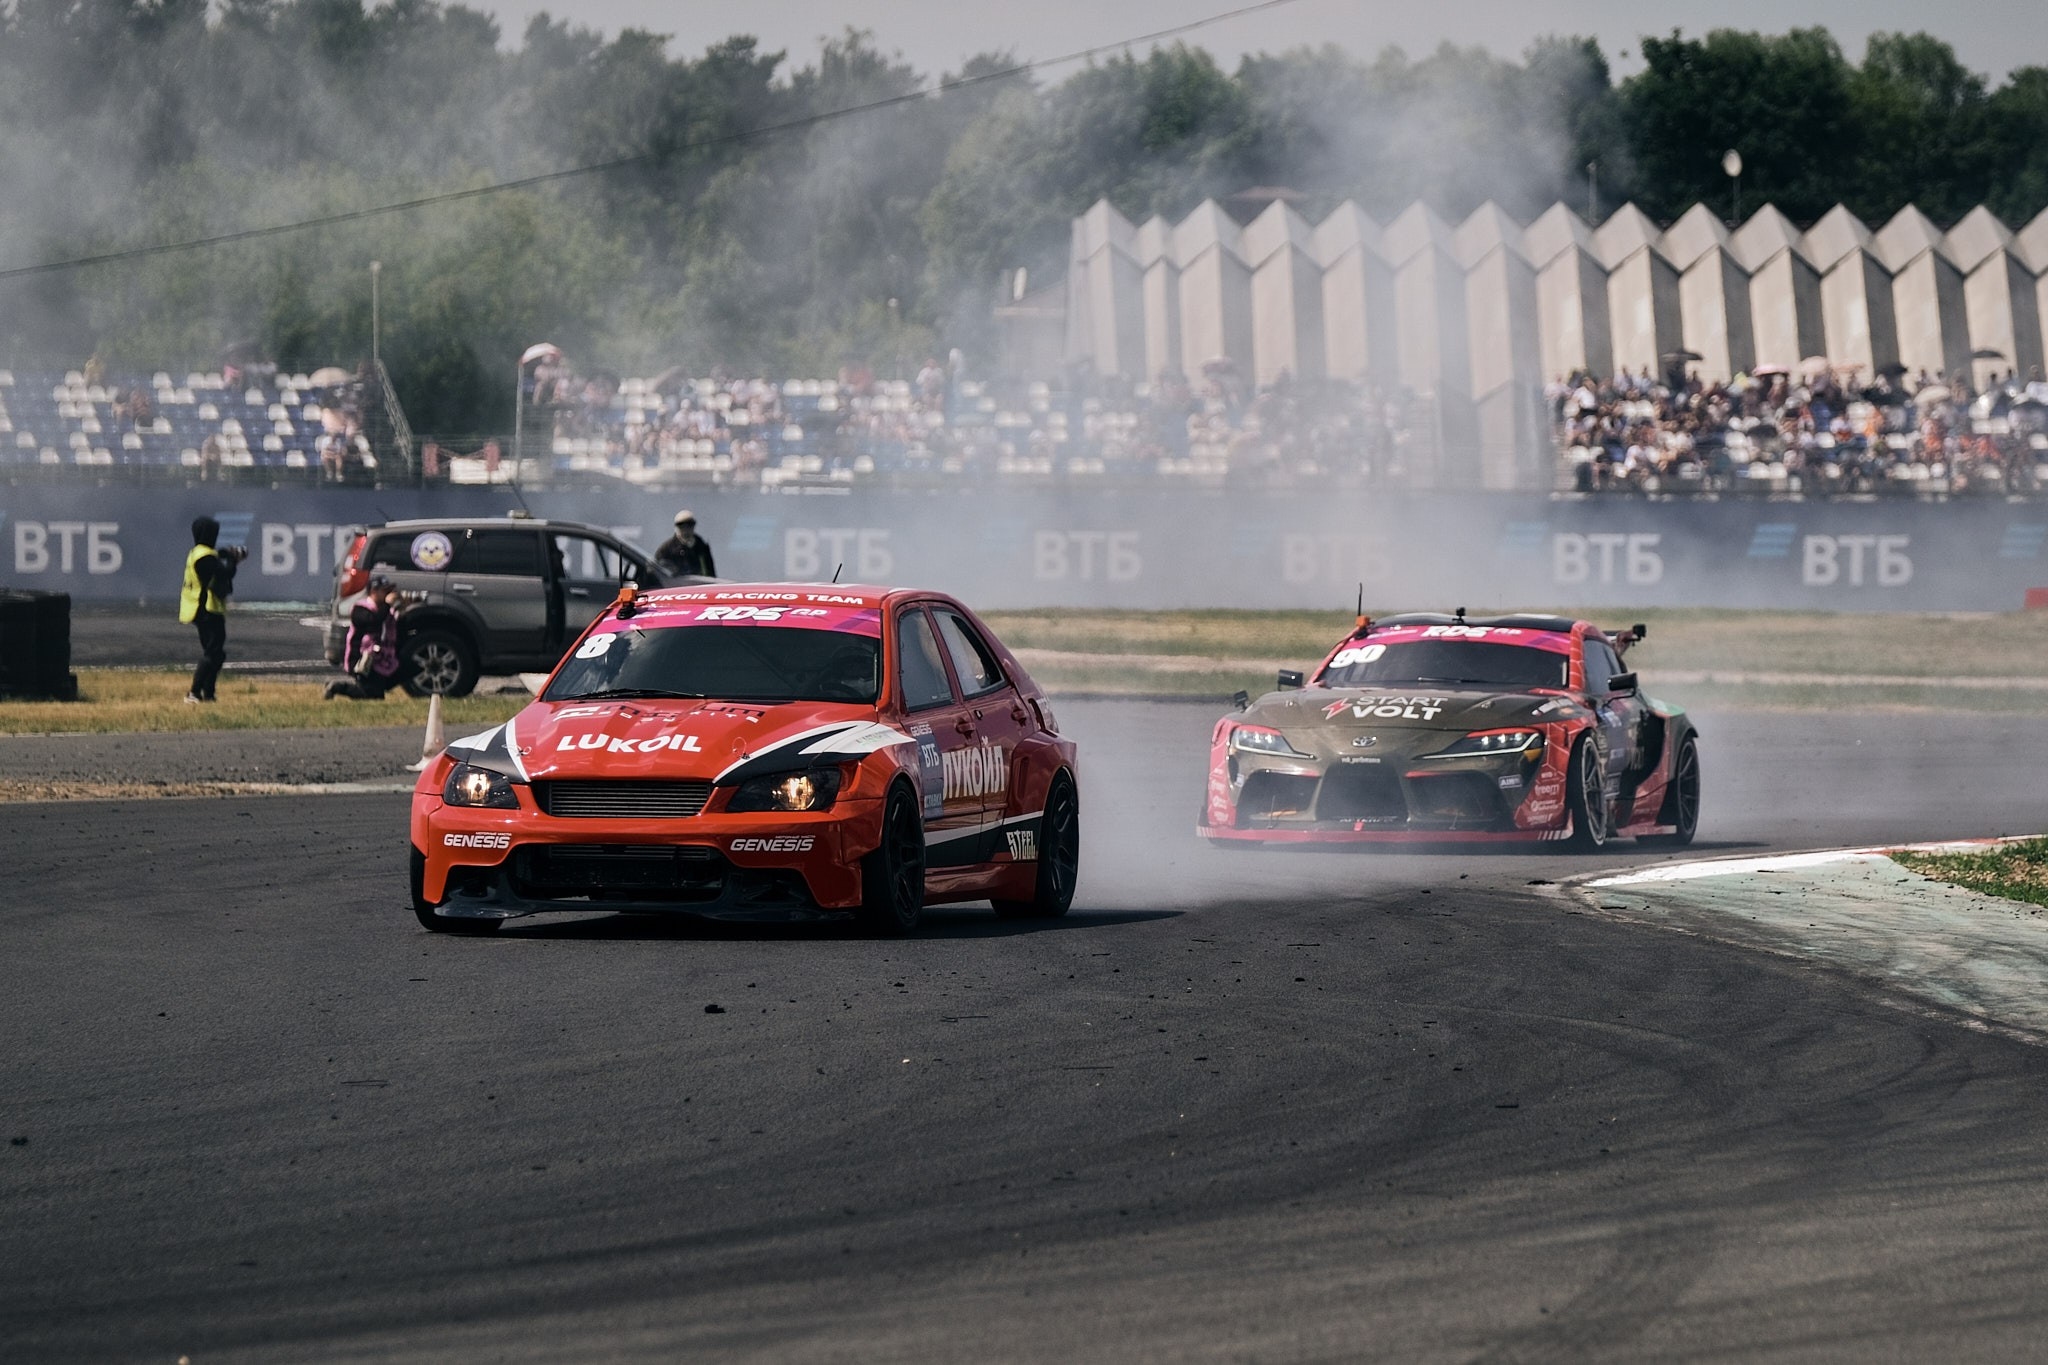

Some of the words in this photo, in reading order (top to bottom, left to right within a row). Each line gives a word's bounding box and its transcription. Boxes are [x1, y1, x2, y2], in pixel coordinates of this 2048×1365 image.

[14, 520, 123, 575] ВТБ
[783, 528, 893, 579] ВТБ
[1032, 530, 1142, 581] ВТБ
[1281, 533, 1392, 583] ВТБ
[1552, 533, 1664, 585] ВТБ
[1801, 534, 1914, 587] ВТБ
[714, 592, 799, 601] RACING
[806, 594, 863, 605] TEAM
[694, 606, 793, 621] RDS
[1421, 625, 1495, 638] RDS
[575, 633, 617, 660] 8
[1329, 644, 1387, 669] 90
[1351, 705, 1442, 721] VOLT
[1356, 695, 1449, 707] START
[556, 733, 702, 753] LUKOIL
[921, 743, 939, 768] ВТБ
[942, 735, 1005, 801] ЛУКОЙЛ
[444, 833, 510, 849] GENESIS
[729, 838, 815, 851] GENESIS
[1006, 829, 1036, 860] STEEL
